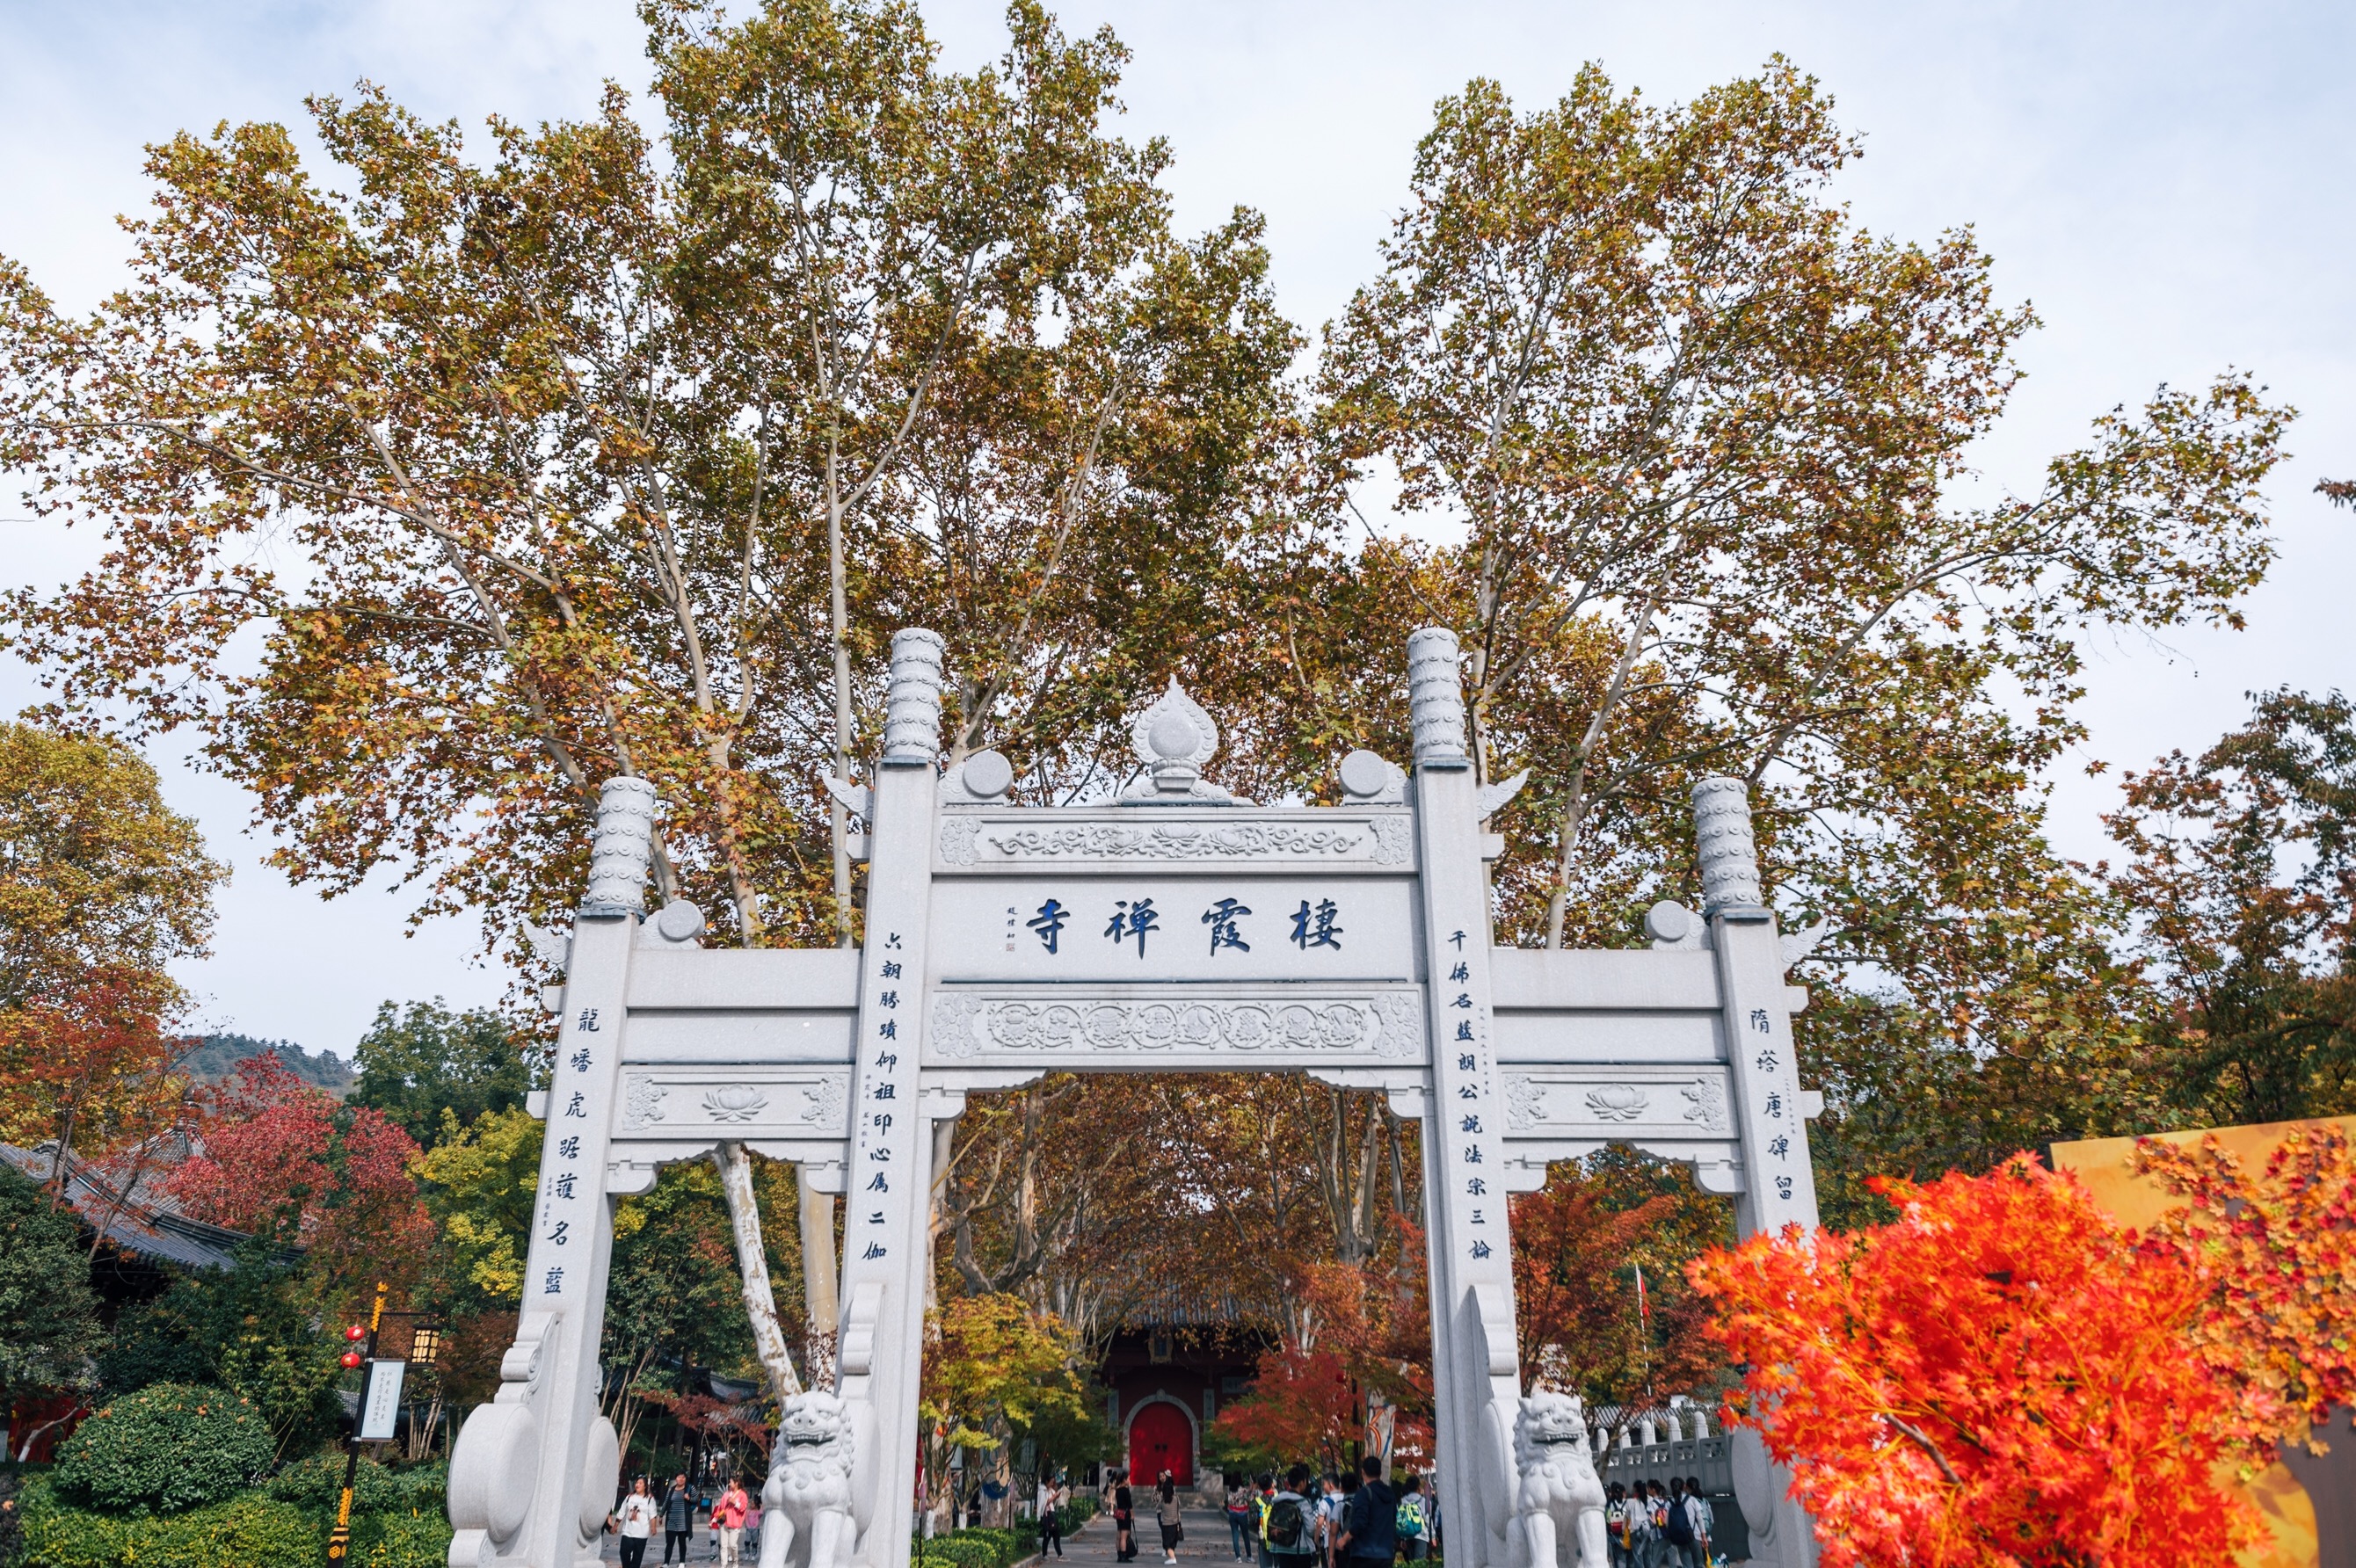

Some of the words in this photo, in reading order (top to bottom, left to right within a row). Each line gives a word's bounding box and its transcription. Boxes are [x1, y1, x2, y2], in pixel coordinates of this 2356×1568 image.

[1750, 1008, 1800, 1241] 隋塔唐碑留
